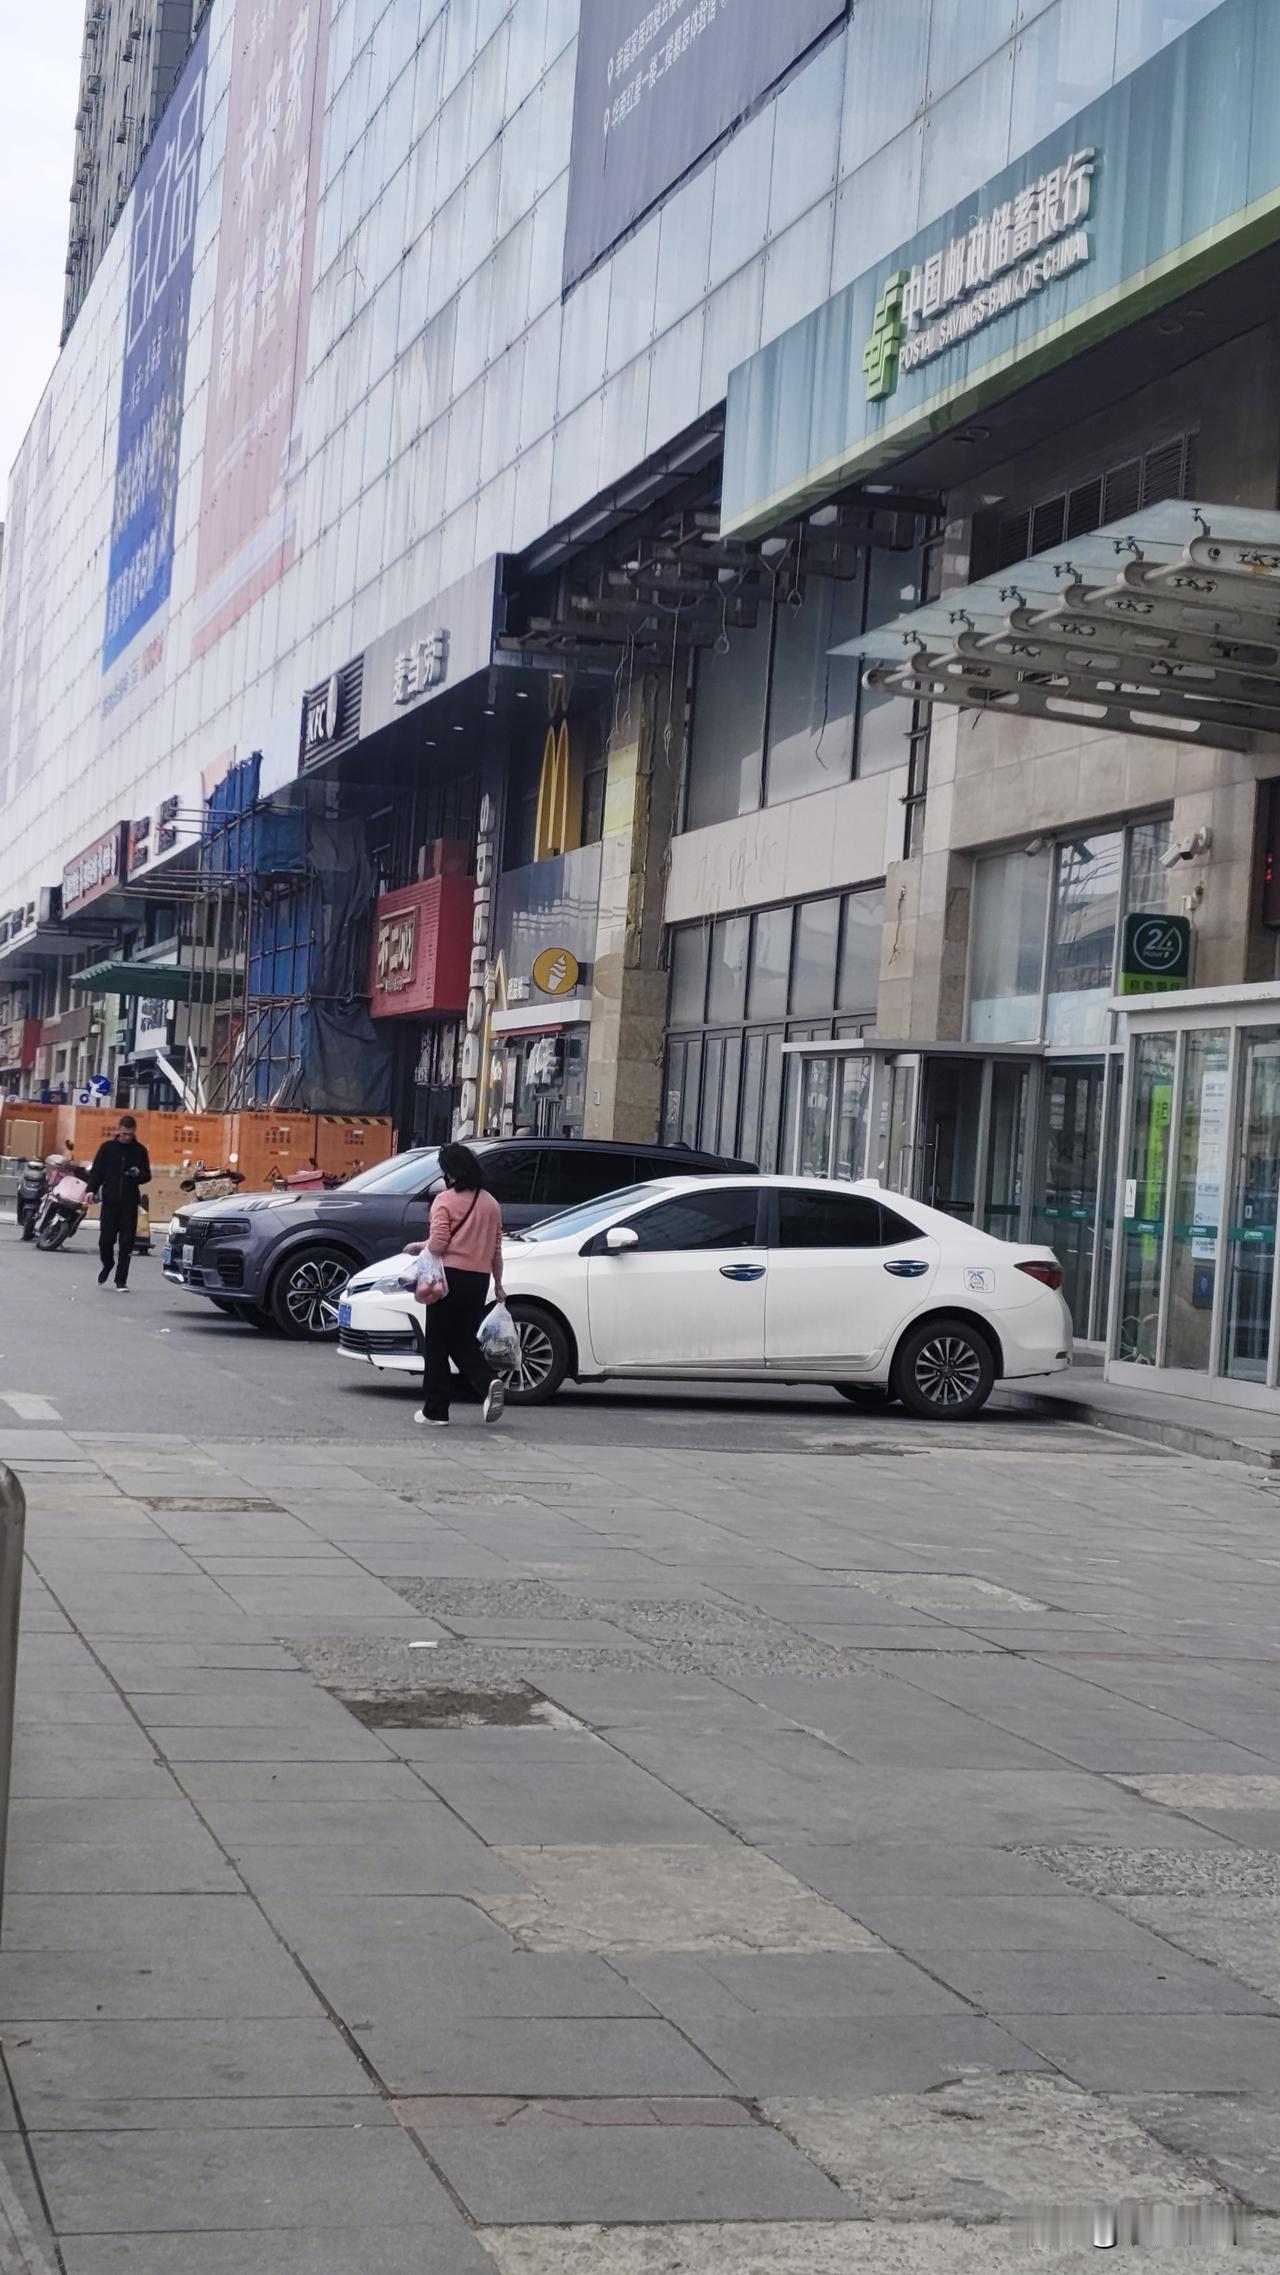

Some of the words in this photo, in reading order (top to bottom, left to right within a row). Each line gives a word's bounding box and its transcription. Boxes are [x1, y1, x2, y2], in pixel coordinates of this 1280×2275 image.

[901, 147, 1096, 331] 中国邮政储蓄银行
[899, 328, 940, 372] POSTAL
[939, 294, 986, 346] SAVINGS
[988, 276, 1021, 317] BANK
[1022, 260, 1044, 290] OF
[1043, 231, 1089, 281] CHINA
[393, 629, 449, 705] 麦当劳
[306, 702, 326, 744] KFC
[378, 924, 413, 977] 不二心
